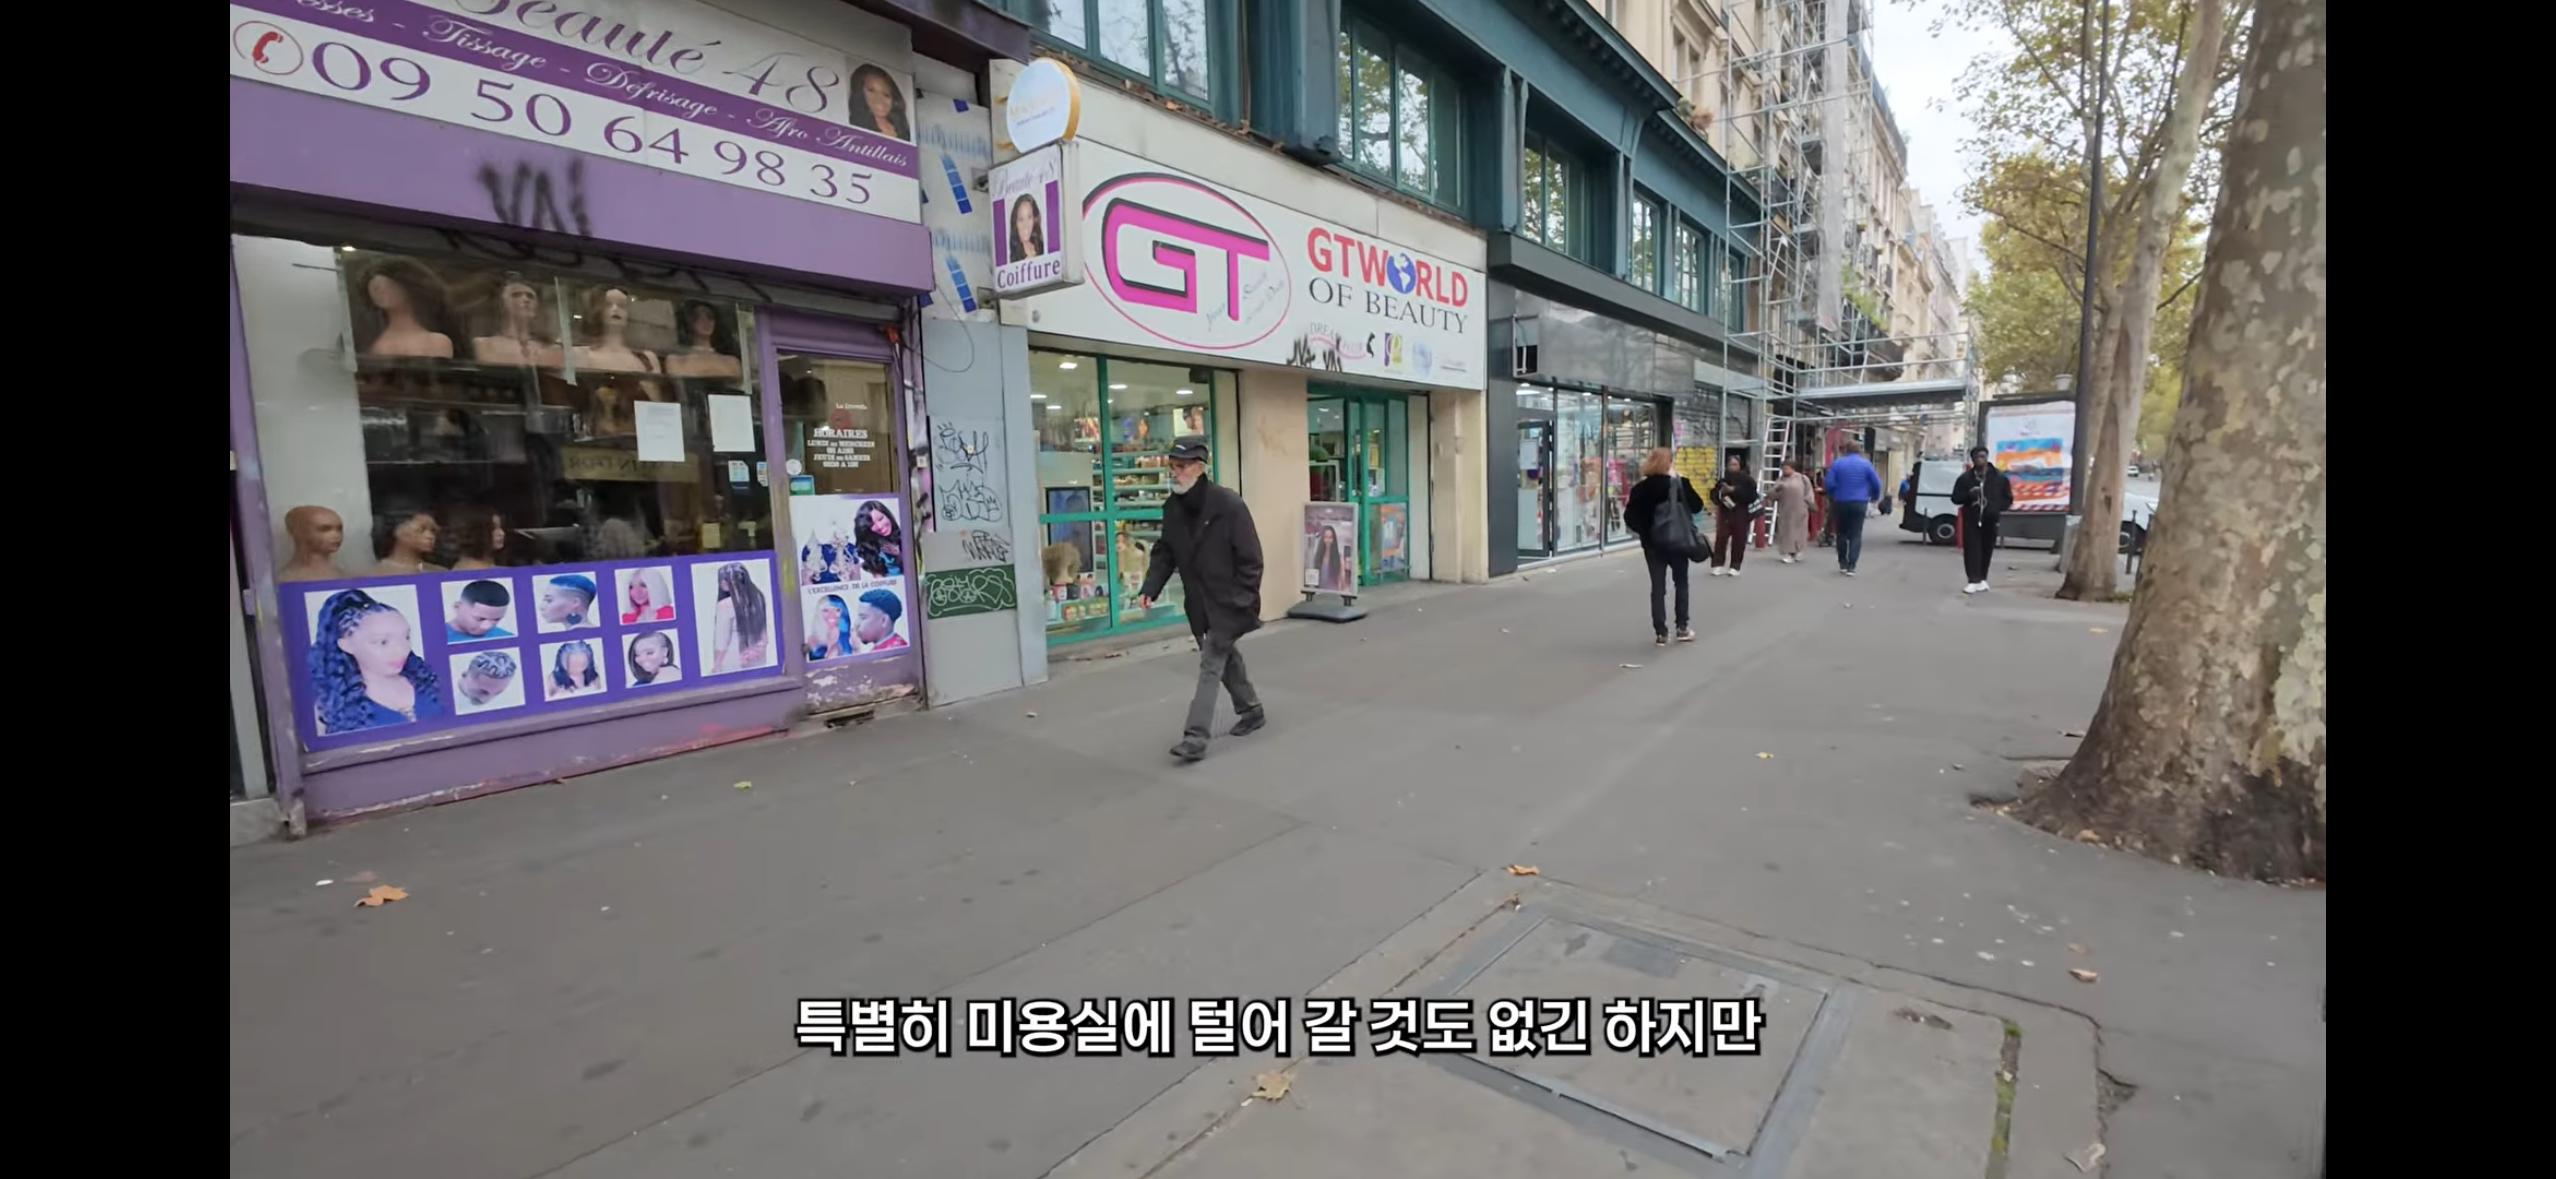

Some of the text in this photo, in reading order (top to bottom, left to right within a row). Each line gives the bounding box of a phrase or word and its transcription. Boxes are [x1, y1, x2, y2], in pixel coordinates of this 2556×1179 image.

[422, 15, 547, 70] Tissage
[746, 108, 809, 139] Afro
[816, 127, 908, 167] Antillais
[722, 51, 840, 113] 48
[311, 41, 872, 205] 09 50 64 98 35
[997, 259, 1061, 289] Coiffure
[1101, 197, 1270, 322] GT
[1309, 276, 1353, 307] OF
[1365, 289, 1468, 334] BEAUTY
[813, 428, 868, 439] HORAIRES
